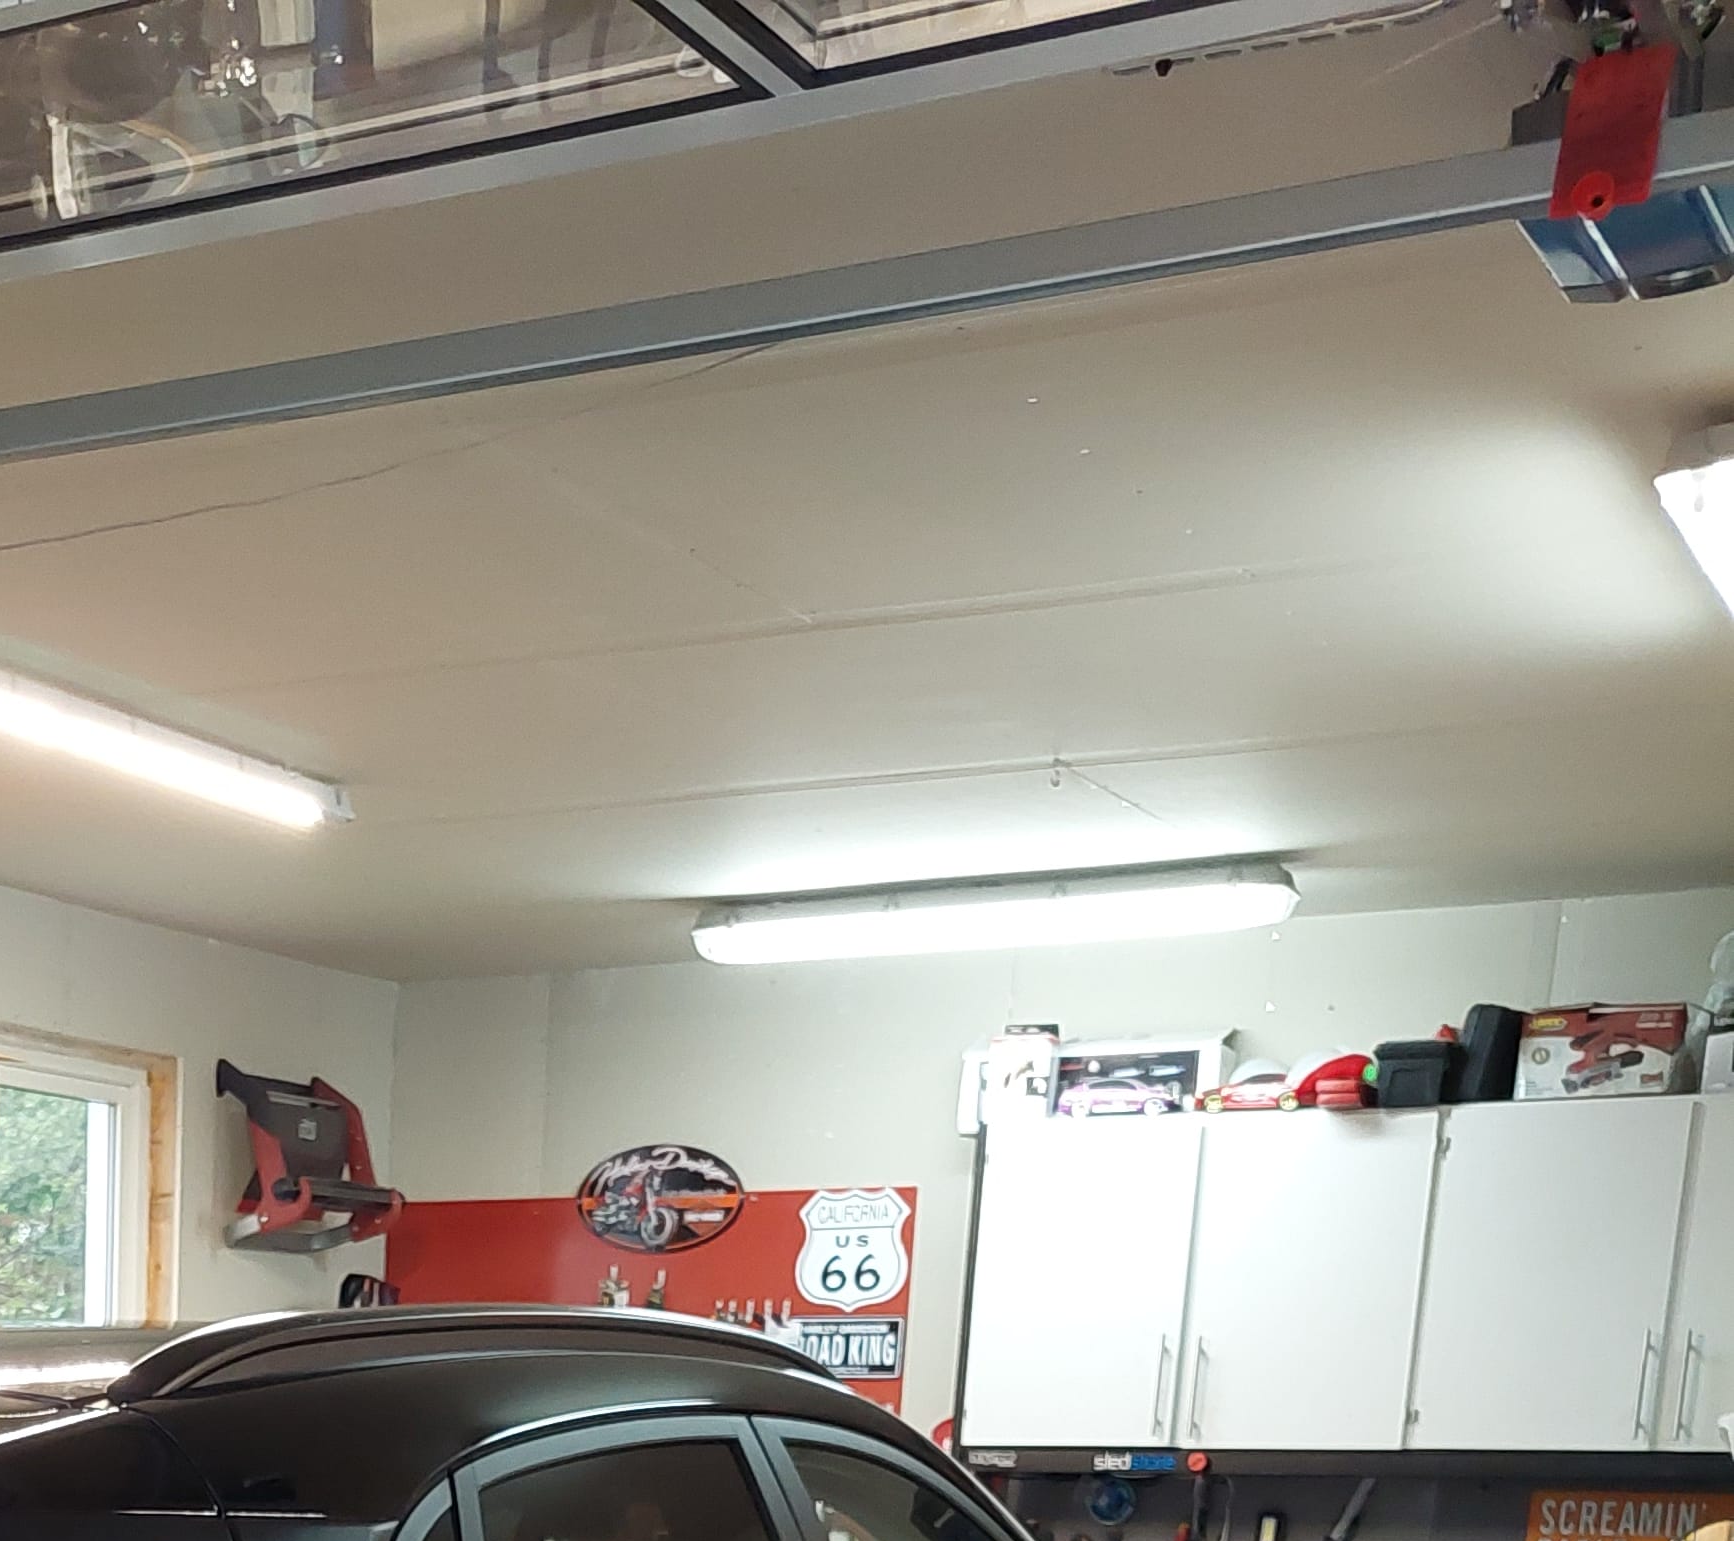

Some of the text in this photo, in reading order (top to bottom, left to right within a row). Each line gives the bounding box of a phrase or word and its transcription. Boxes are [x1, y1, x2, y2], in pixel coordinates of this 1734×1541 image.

[817, 1205, 890, 1225] CALIFORNIA
[821, 1254, 881, 1292] 66
[847, 1332, 897, 1367] KING
